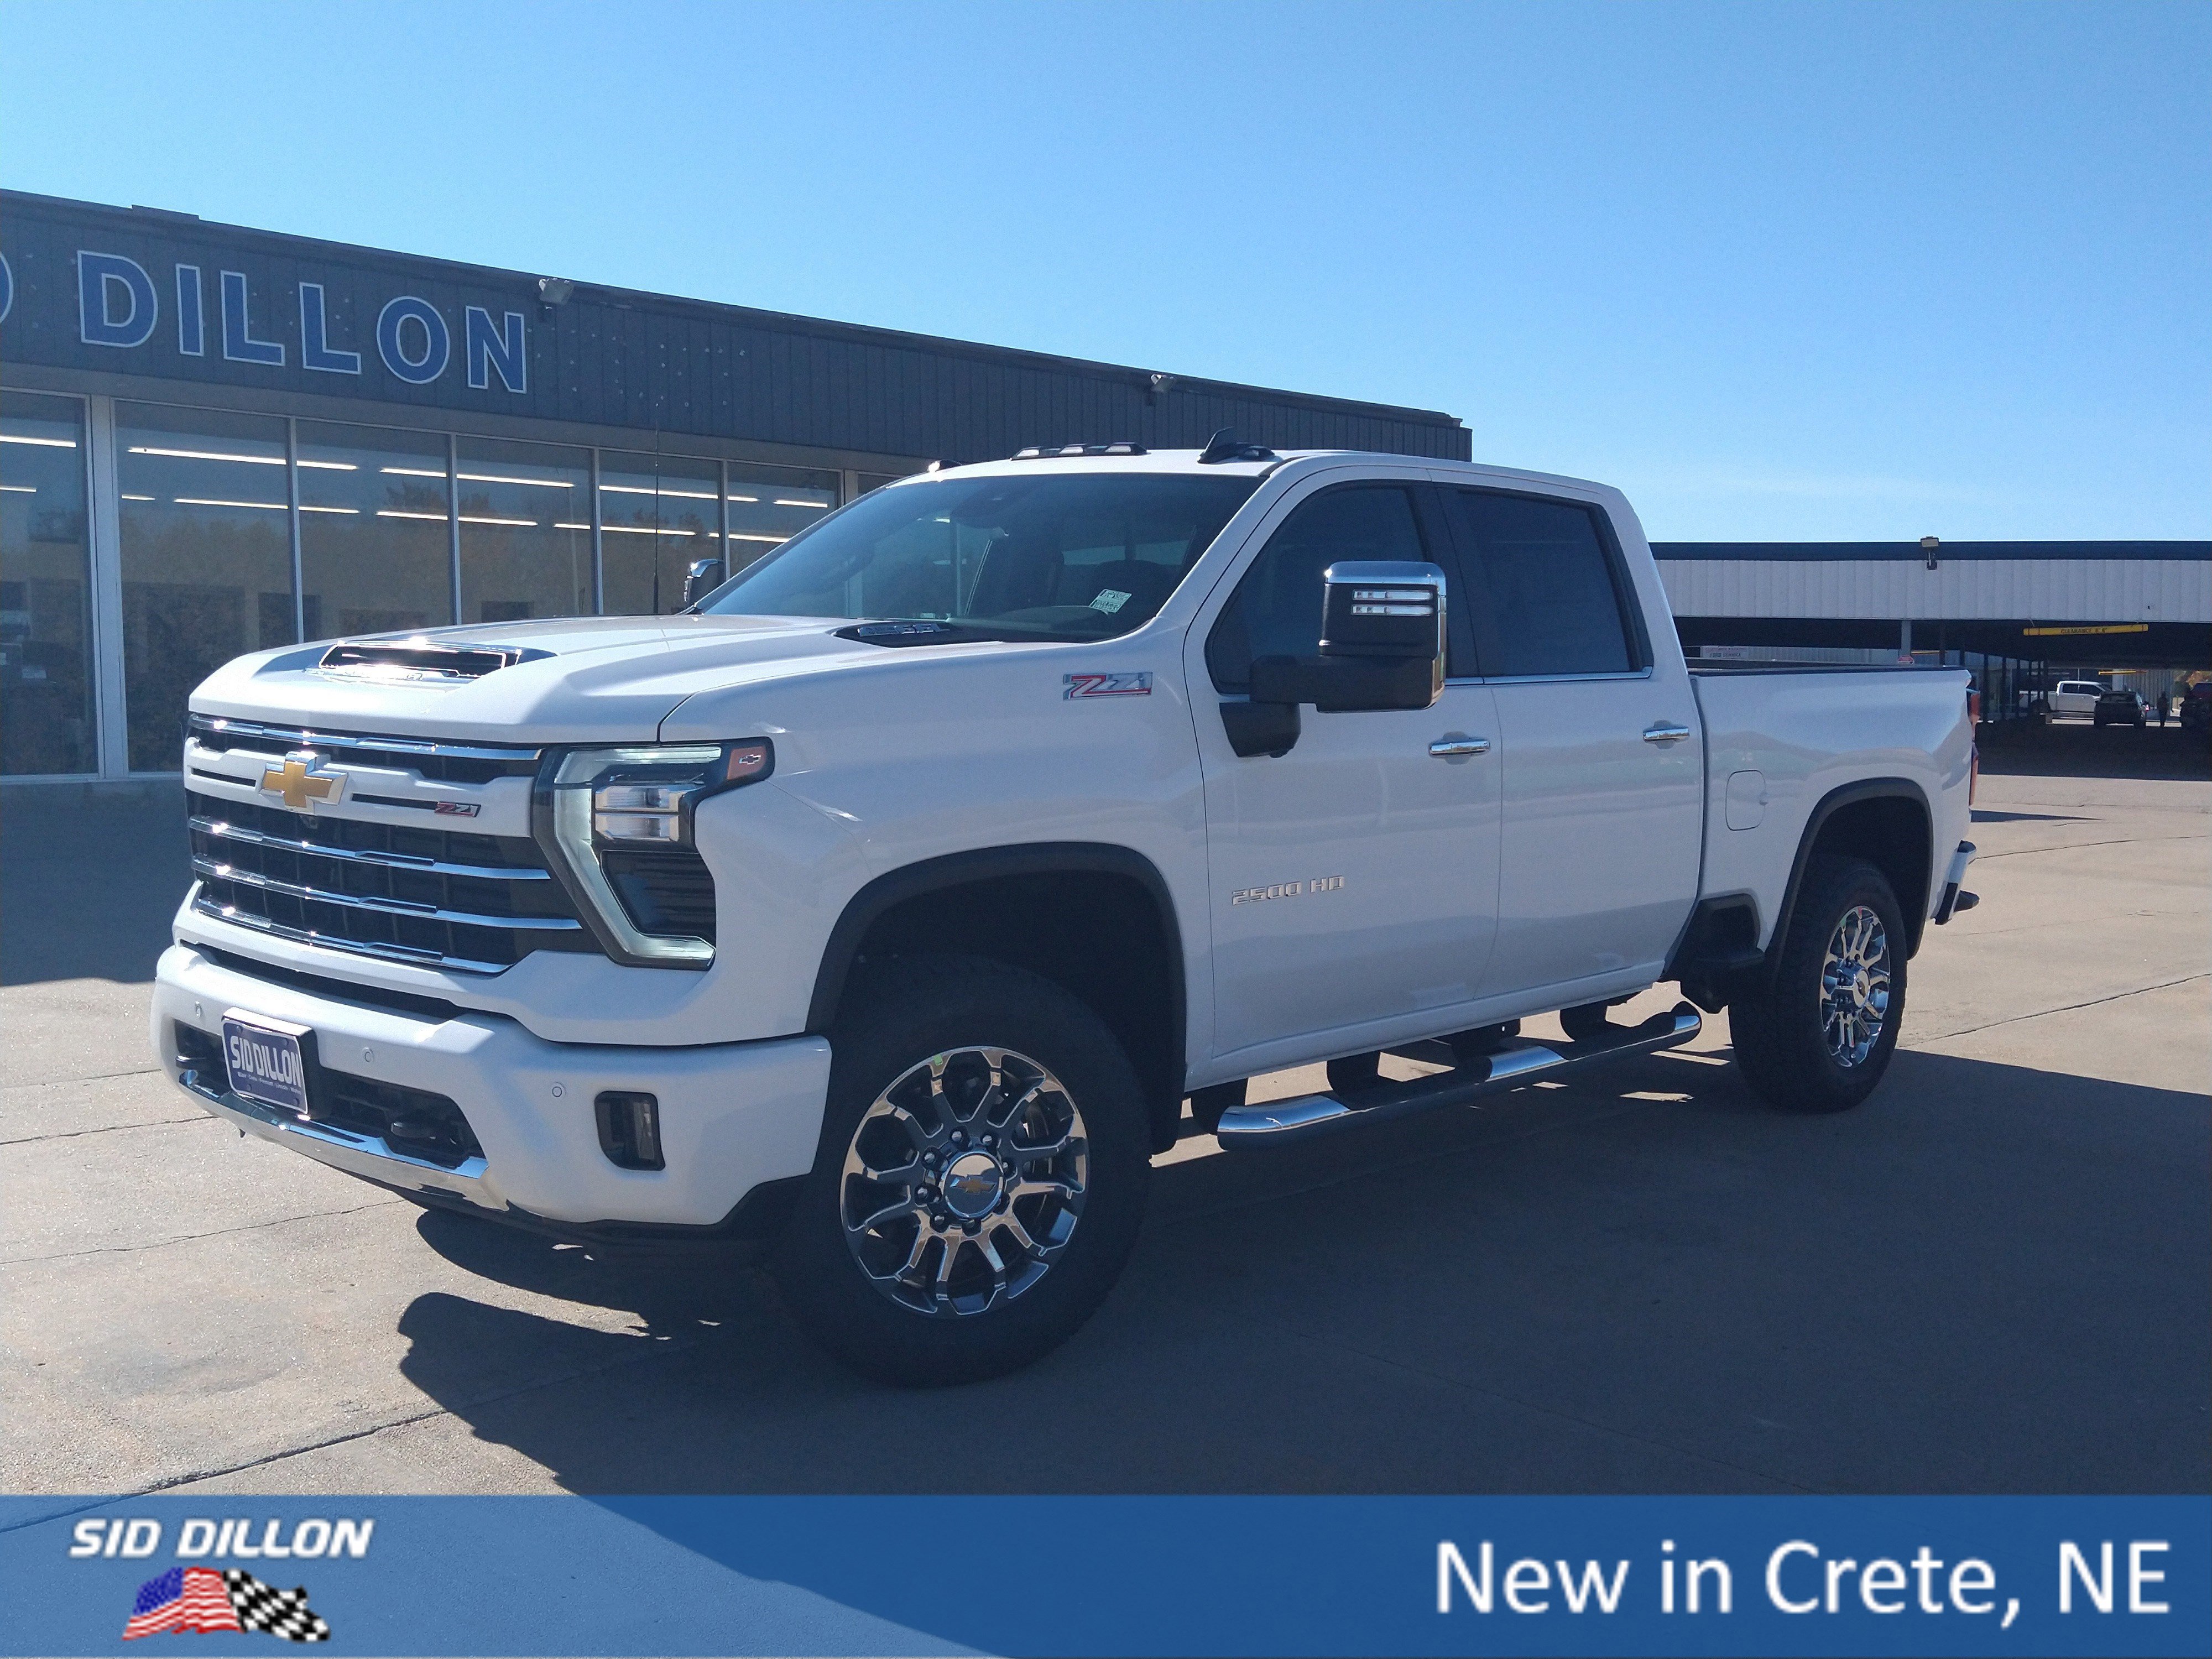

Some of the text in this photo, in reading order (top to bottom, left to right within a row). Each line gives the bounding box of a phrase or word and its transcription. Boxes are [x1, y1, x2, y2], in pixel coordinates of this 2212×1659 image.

[76, 249, 528, 394] DILLON
[1063, 672, 1153, 701] Z71
[1232, 875, 1344, 905] 2500 HD
[230, 1035, 254, 1073] SID
[252, 1042, 301, 1088] DILLON
